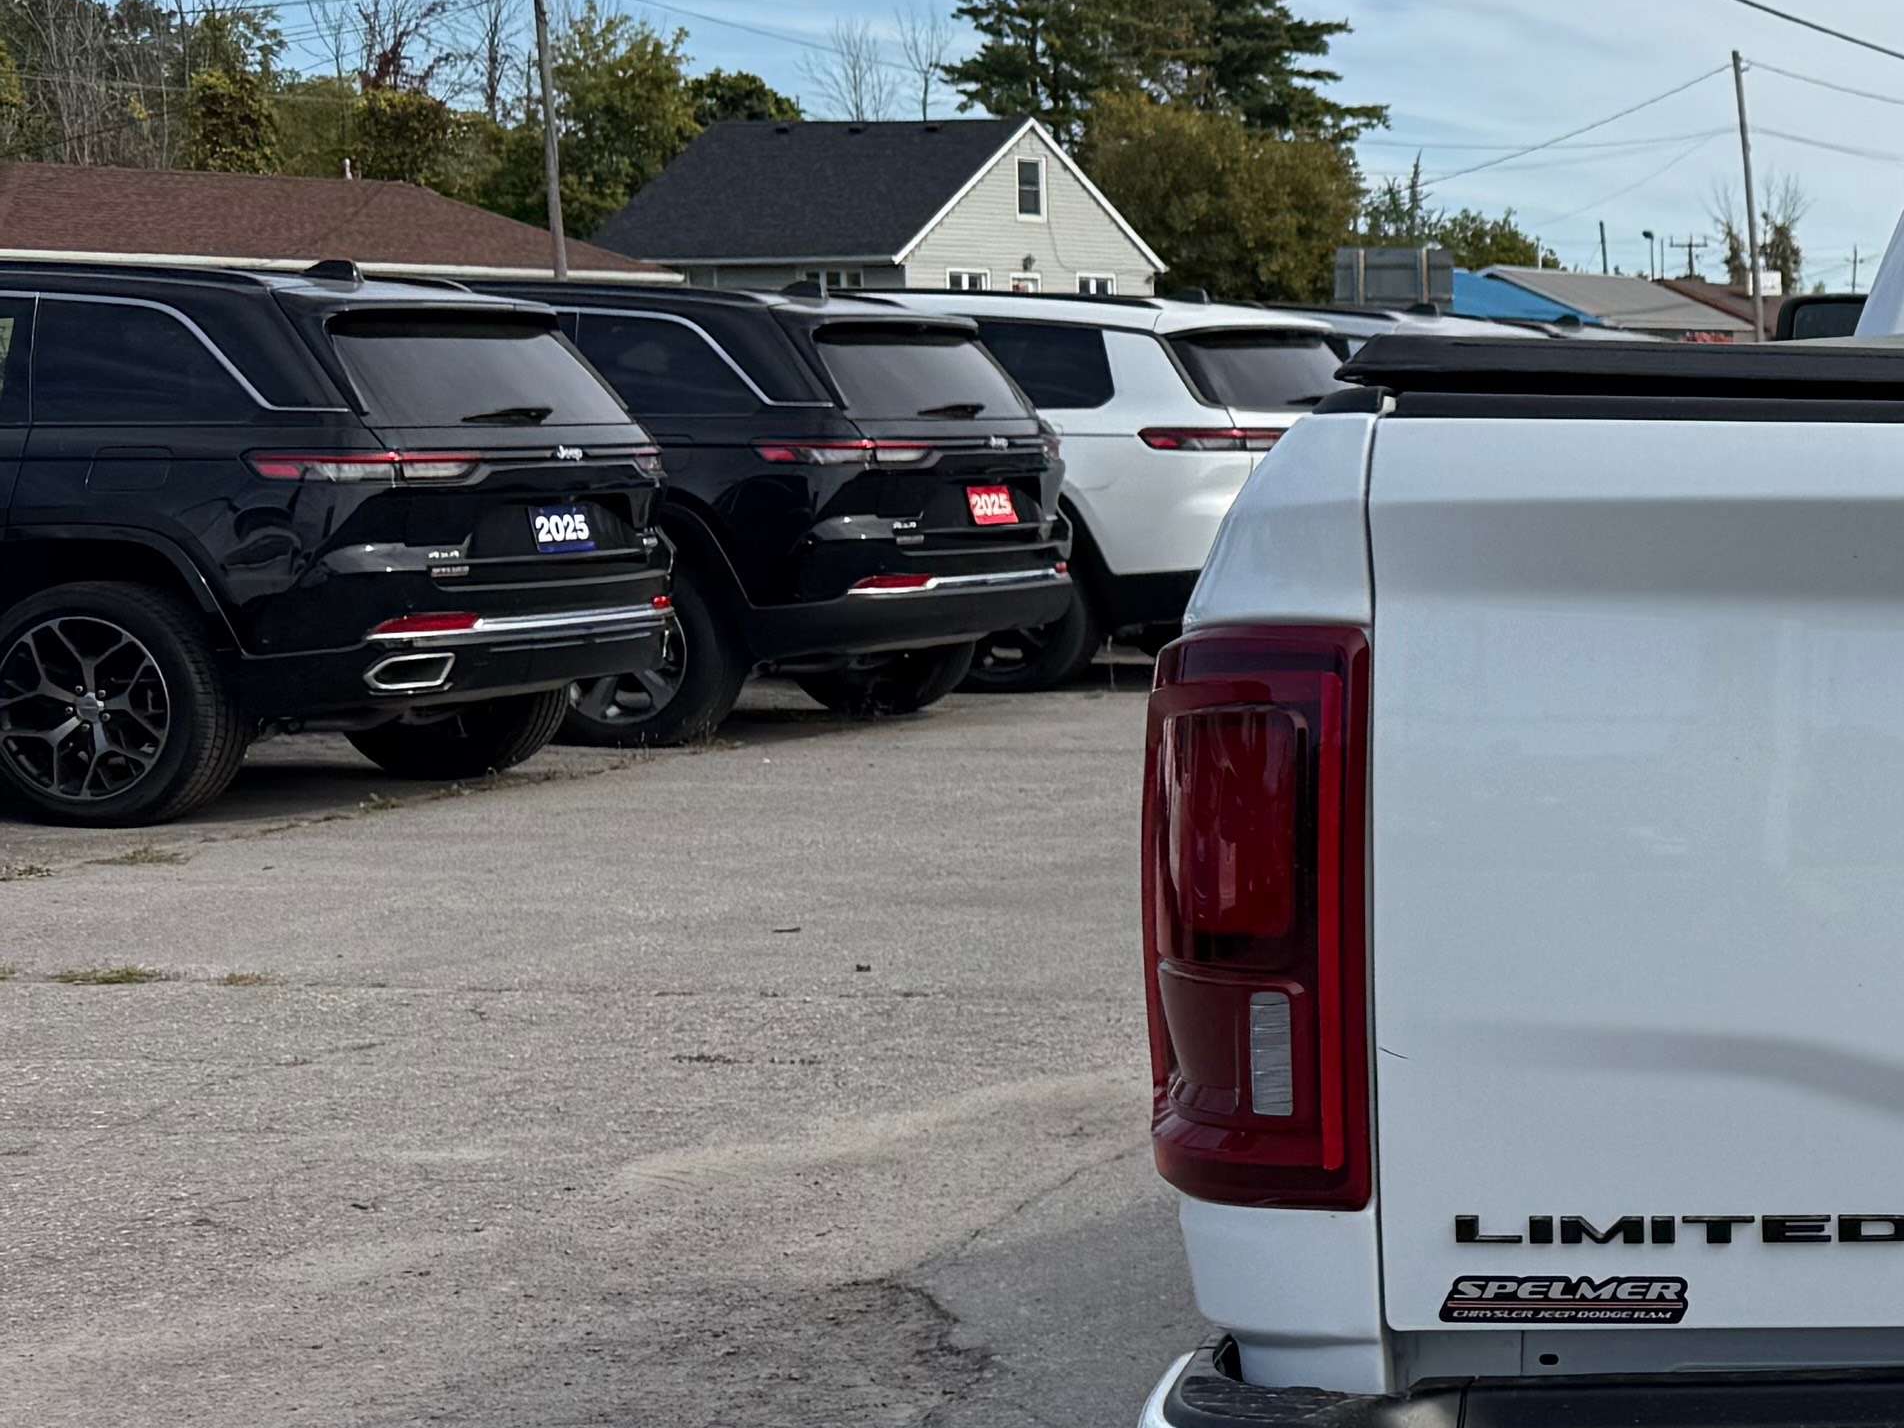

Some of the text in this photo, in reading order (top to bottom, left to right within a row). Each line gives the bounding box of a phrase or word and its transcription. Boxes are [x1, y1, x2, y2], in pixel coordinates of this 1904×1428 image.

[970, 493, 1013, 517] 2025
[534, 514, 590, 543] 2025
[1453, 1280, 1683, 1300] SPELMER
[1452, 1309, 1673, 1319] CHRYSLER JEEP DODGE RAM
